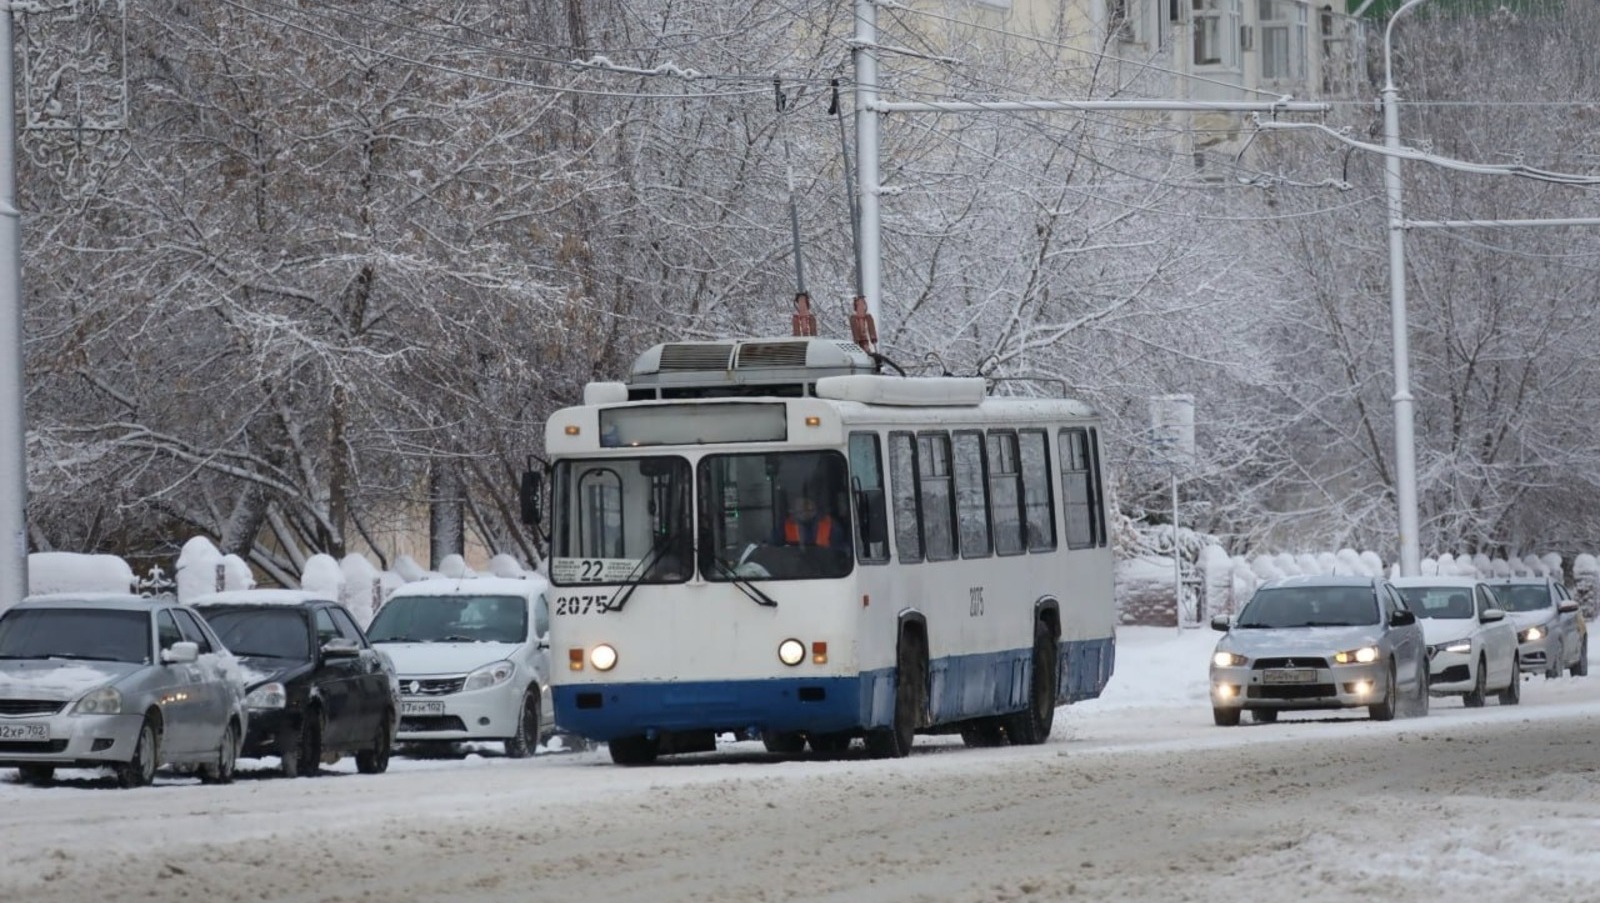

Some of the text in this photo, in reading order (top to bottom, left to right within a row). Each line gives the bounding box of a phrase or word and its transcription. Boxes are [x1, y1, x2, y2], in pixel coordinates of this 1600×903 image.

[581, 560, 604, 582] 22
[556, 595, 608, 616] 2075
[969, 586, 985, 617] 2075
[26, 725, 45, 737] 702
